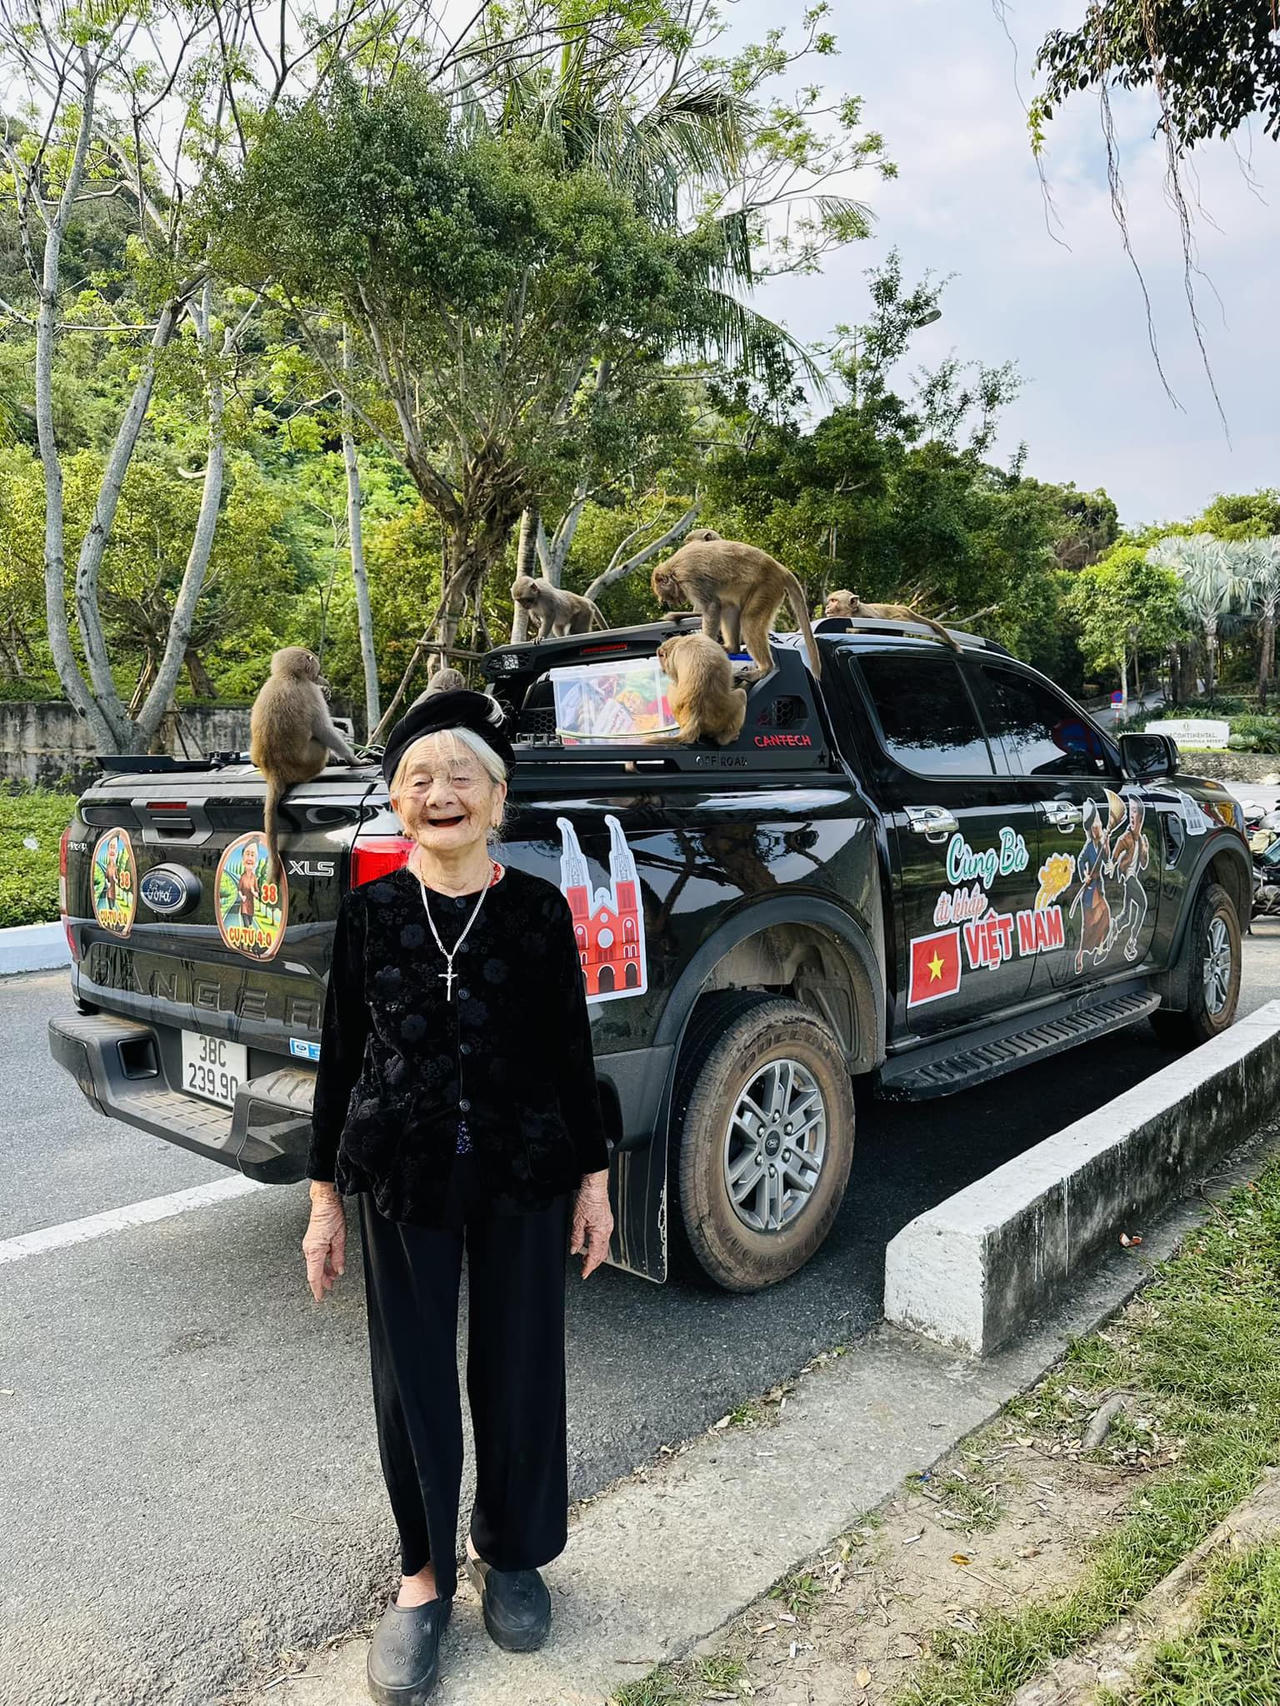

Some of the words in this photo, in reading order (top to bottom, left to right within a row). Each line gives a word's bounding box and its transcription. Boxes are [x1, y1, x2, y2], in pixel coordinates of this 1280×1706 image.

[754, 735, 812, 747] CANTECH
[288, 861, 335, 876] XLS
[948, 834, 998, 888] Cùng
[1001, 829, 1028, 874] Bà
[119, 871, 131, 889] 38
[145, 878, 174, 903] Ford
[261, 884, 278, 904] 38
[1017, 907, 1064, 955] NAM
[199, 1036, 227, 1068] 38C
[188, 1062, 238, 1102] 239.90
